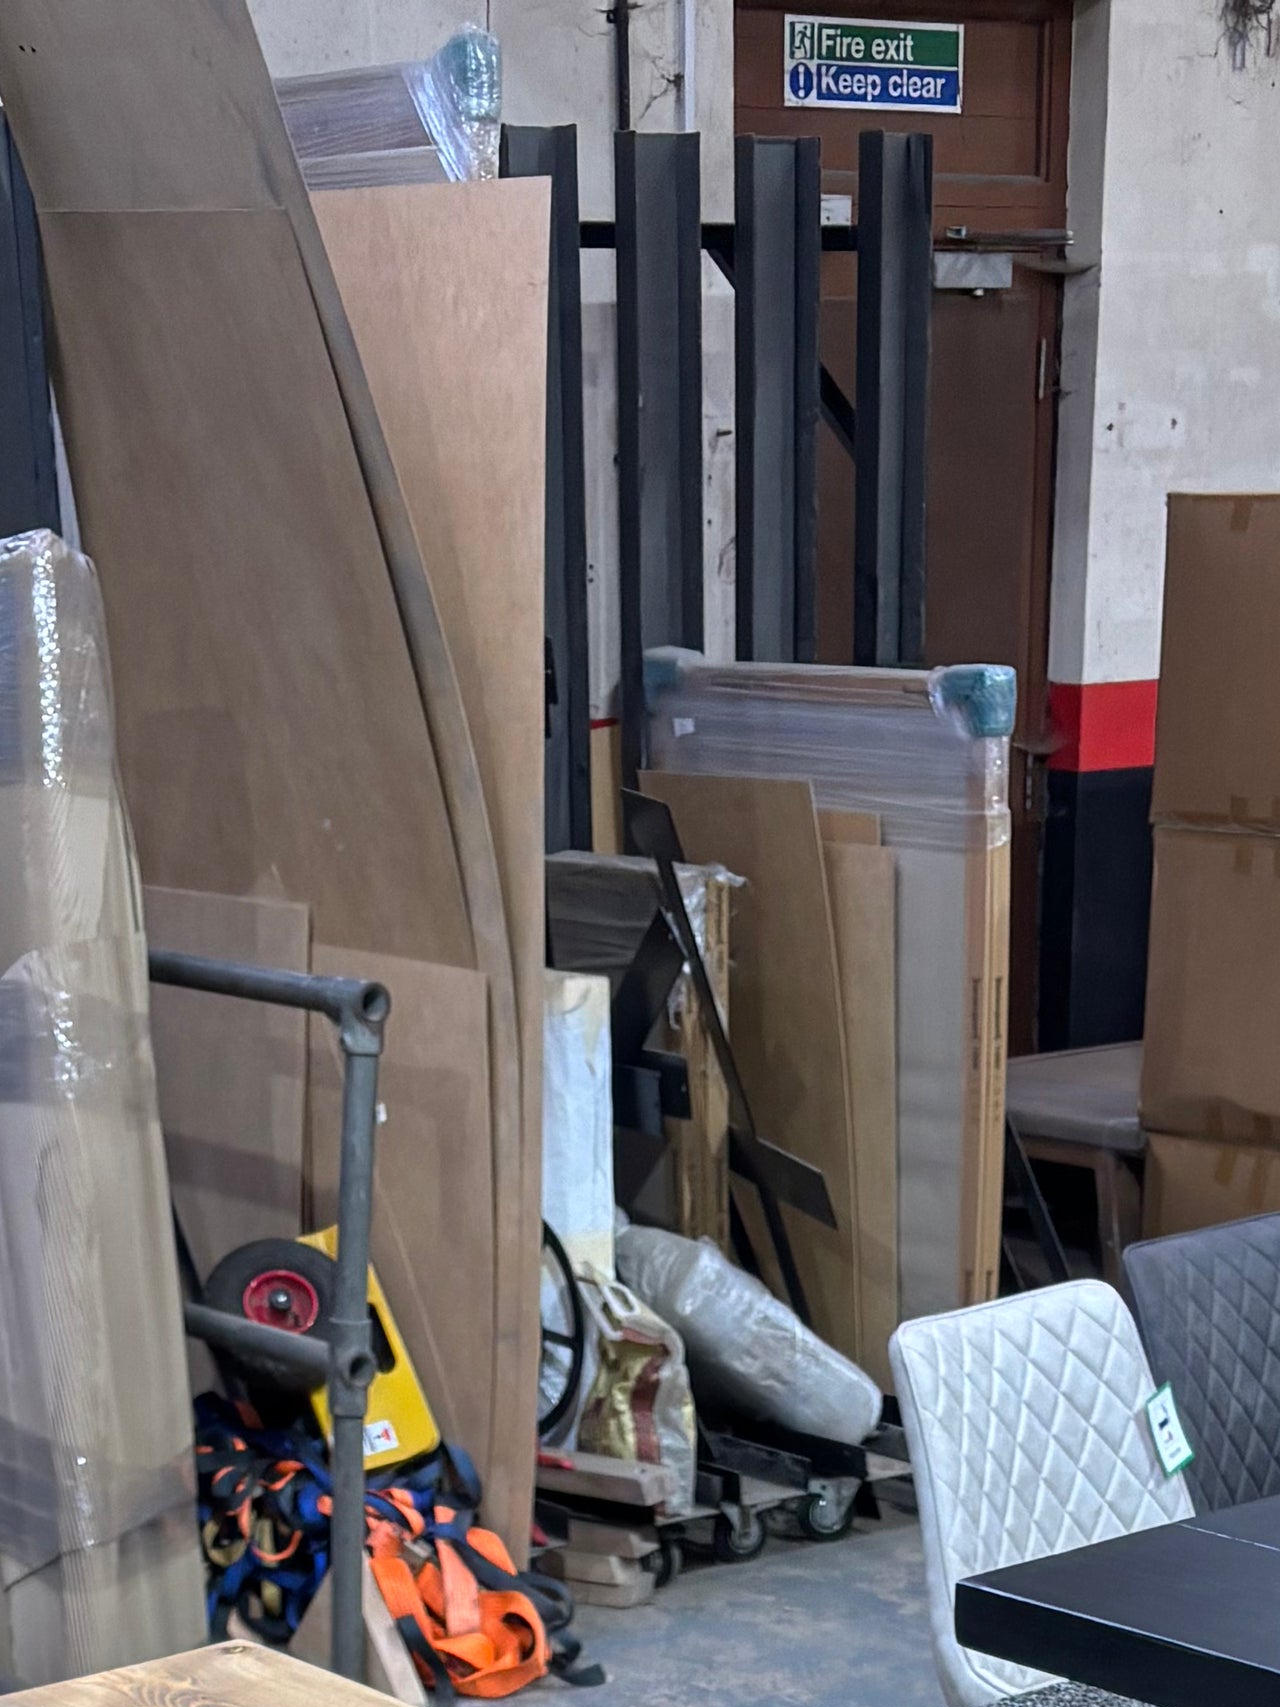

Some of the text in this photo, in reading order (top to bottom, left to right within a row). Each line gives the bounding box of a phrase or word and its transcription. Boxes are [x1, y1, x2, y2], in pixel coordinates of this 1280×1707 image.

[821, 28, 915, 62] Fire exit
[820, 65, 946, 101] Keep clear
